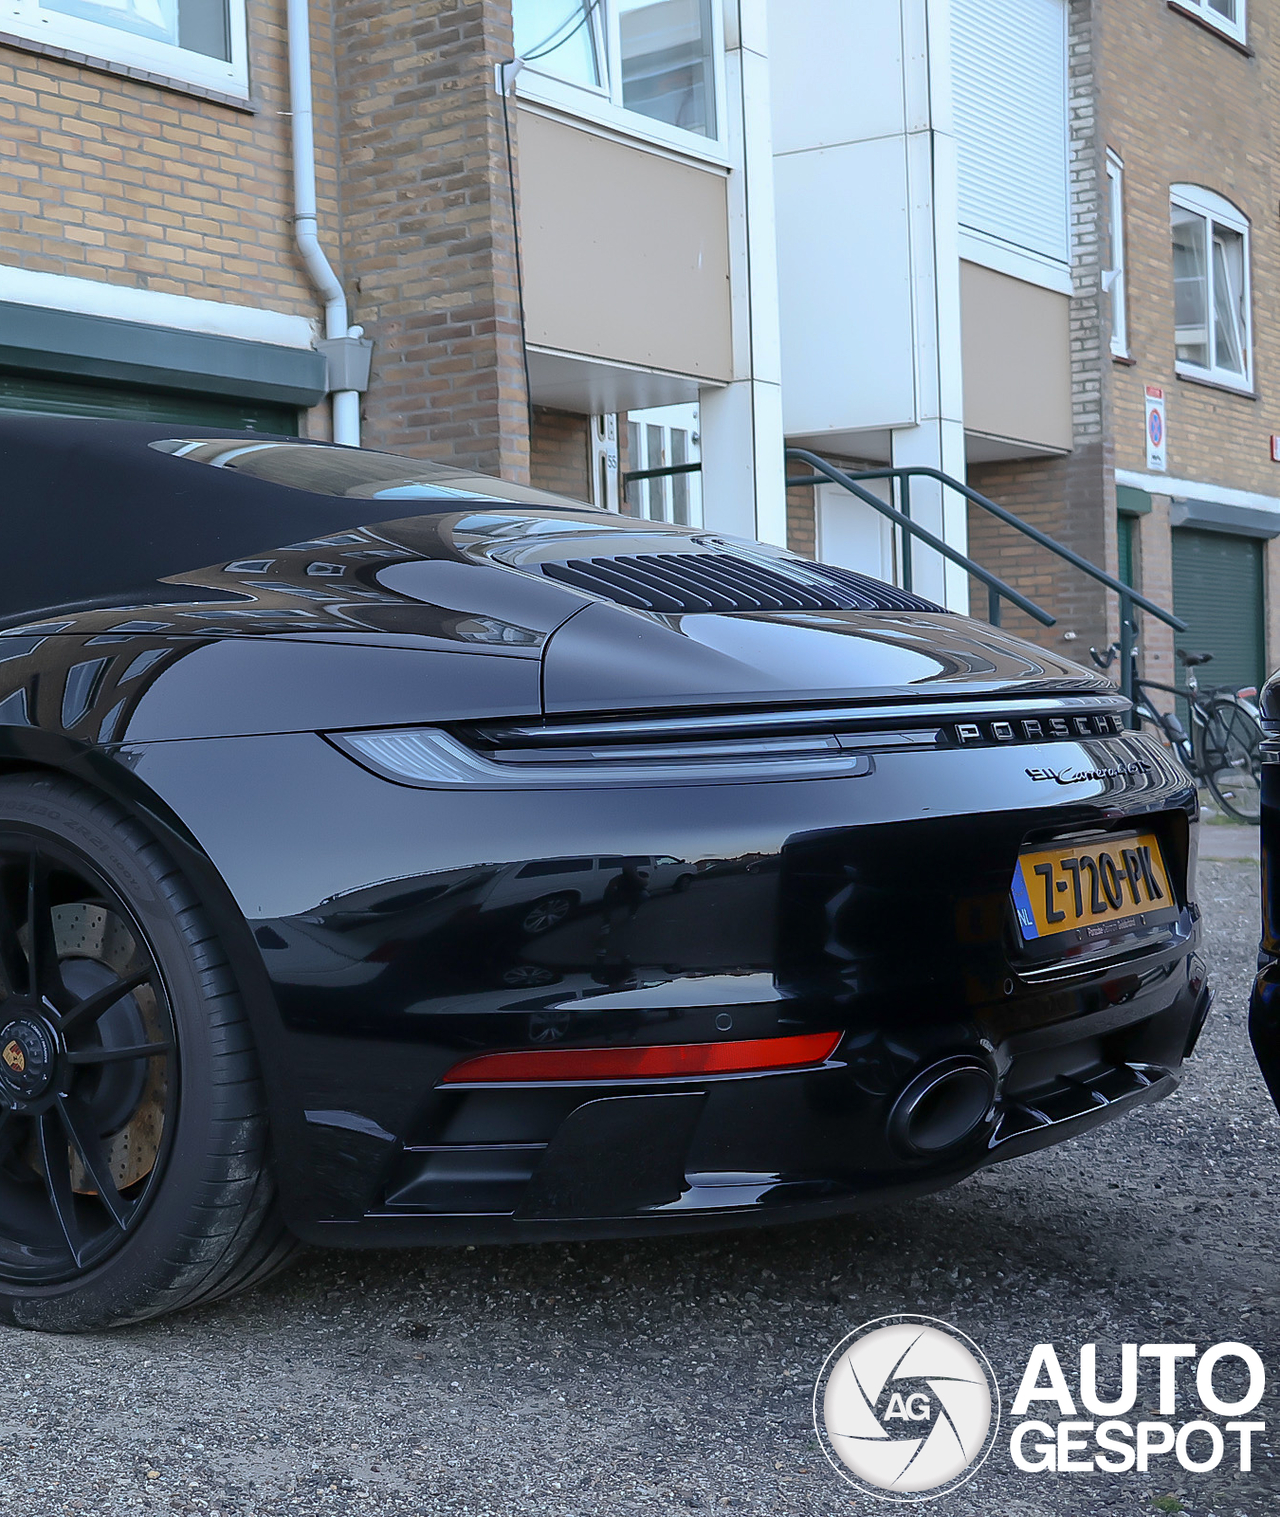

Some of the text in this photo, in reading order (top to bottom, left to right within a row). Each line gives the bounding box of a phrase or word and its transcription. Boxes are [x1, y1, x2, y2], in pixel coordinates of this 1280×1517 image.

[607, 454, 617, 468] 55
[955, 714, 1124, 743] PORSCHE
[1055, 766, 1117, 785] Carrera
[1034, 846, 1164, 924] Z-720-PK
[1017, 908, 1033, 927] NL
